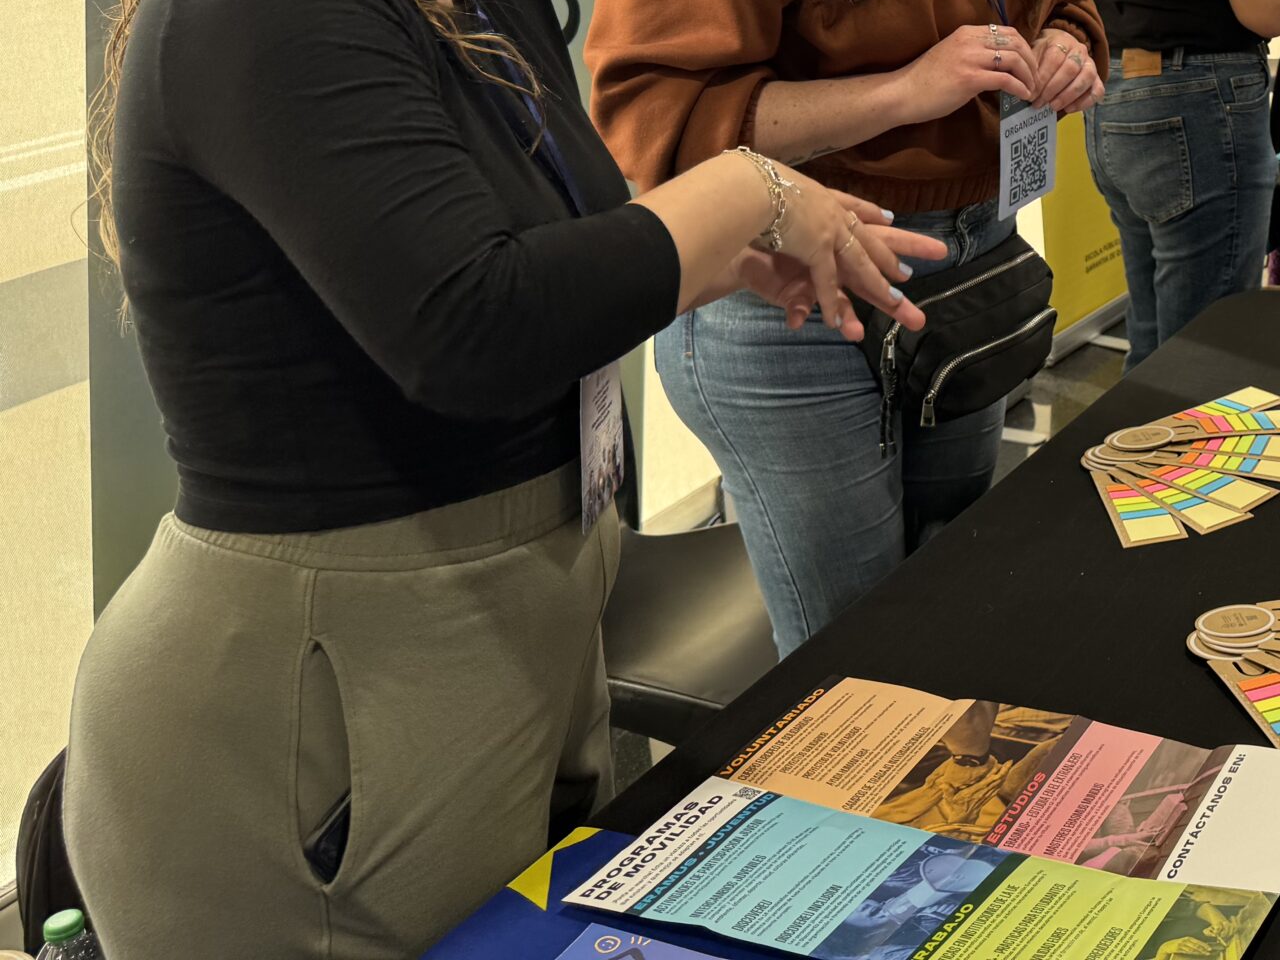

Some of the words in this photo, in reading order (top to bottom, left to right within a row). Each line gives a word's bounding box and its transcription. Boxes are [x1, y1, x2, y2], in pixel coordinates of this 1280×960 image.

[720, 687, 826, 778] VOLUNTARIADO
[578, 800, 701, 898] PROGRAMAS
[593, 880, 626, 901] DE
[620, 794, 725, 878] MOVILIDAD
[699, 791, 776, 850] JUVENTUD
[988, 770, 1047, 846] ESTUDIOS
[1166, 776, 1234, 880] CONTÁCTANOS
[1230, 752, 1247, 774] EN:
[729, 898, 774, 932] DISCOVEREU
[914, 903, 975, 960] RABAJO
